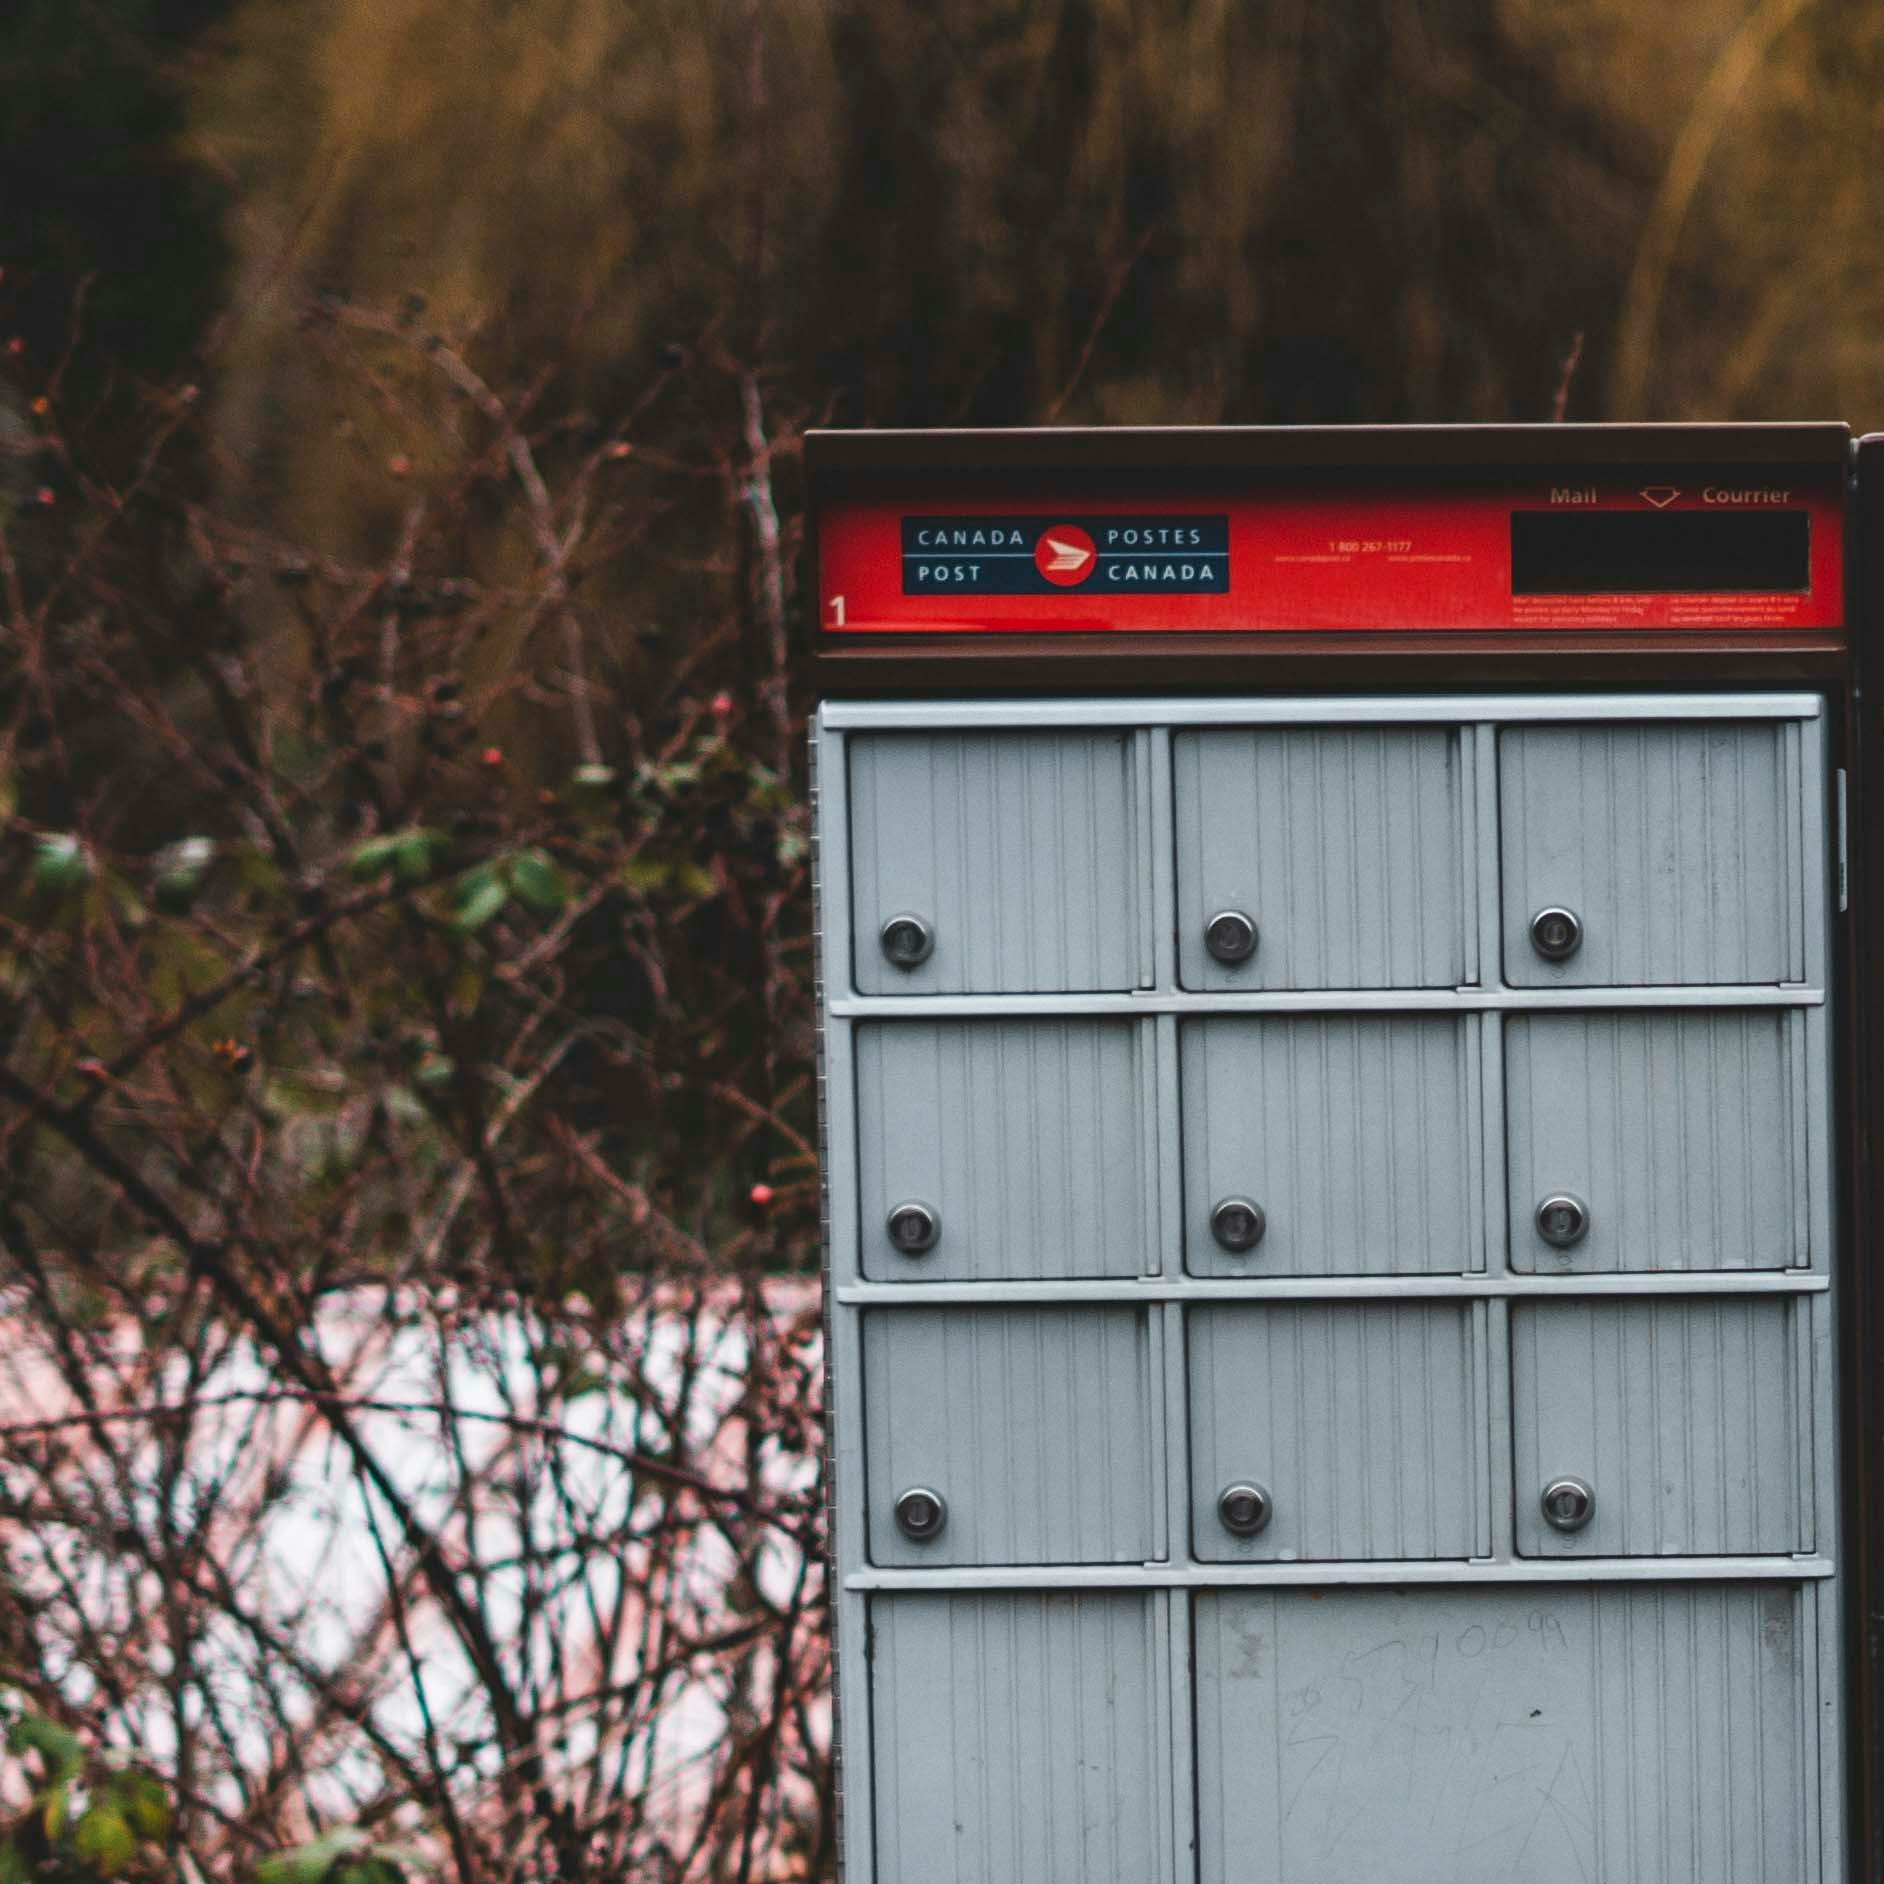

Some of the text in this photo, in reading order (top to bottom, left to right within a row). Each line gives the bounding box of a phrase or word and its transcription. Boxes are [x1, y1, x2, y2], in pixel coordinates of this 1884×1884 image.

[1550, 487, 1597, 504] Mail
[1702, 486, 1792, 504] Courrier
[918, 529, 1024, 546] CANADA
[1107, 528, 1201, 545] POSTES
[1338, 541, 1360, 552] 800
[918, 565, 982, 582] POST
[1107, 564, 1215, 581] CANADA
[829, 595, 847, 627] 1
